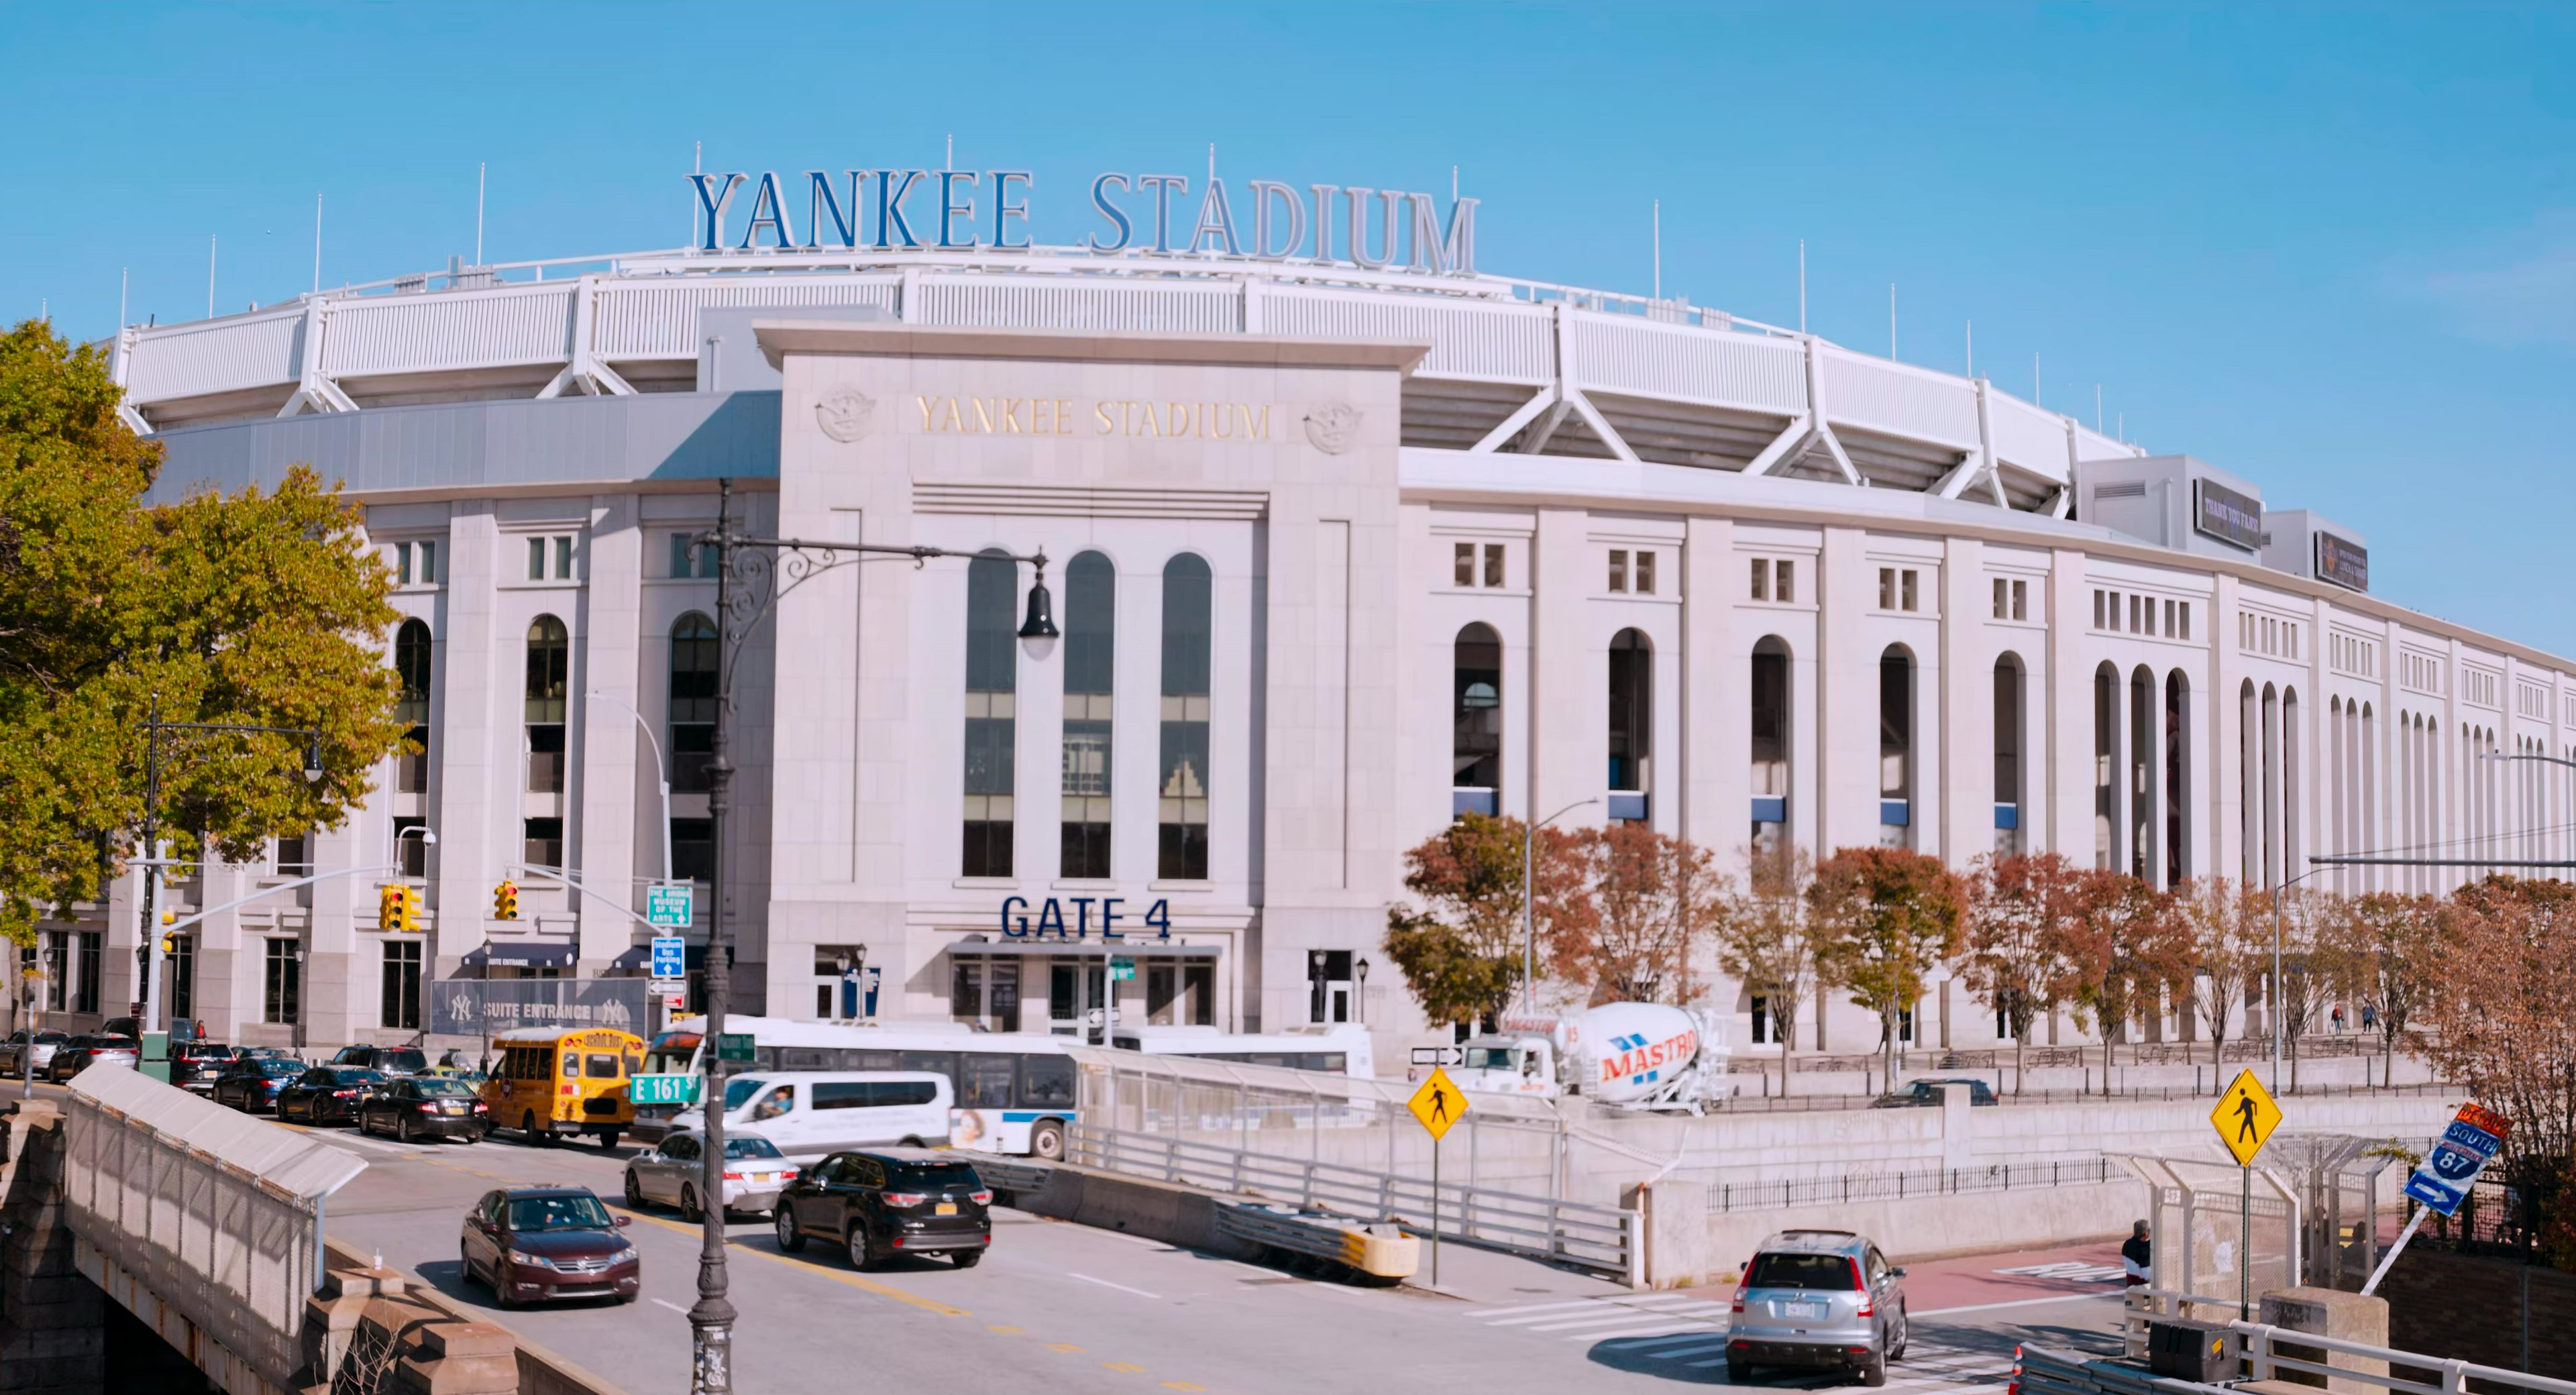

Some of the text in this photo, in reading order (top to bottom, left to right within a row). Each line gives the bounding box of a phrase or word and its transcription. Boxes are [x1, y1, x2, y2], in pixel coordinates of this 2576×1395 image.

[683, 170, 1481, 276] YANKEE STADIUM
[916, 395, 1271, 441] YANKEE STADIUM
[2205, 497, 2227, 521] THANK
[2227, 506, 2241, 526] YOU
[653, 897, 686, 905] MUSEUM
[666, 890, 690, 898] BRONX
[653, 914, 673, 922] ARTS
[1002, 896, 1171, 938] GATE 4
[655, 940, 682, 948] Stadium
[661, 948, 674, 956] Bus
[655, 956, 681, 965] Parking
[484, 1003, 591, 1020] SUITE ENTRANCE
[585, 1034, 622, 1048] SCHOOL BUS
[1601, 1029, 1696, 1085] MASTRO
[636, 1078, 645, 1100] E
[653, 1078, 680, 1100] 161
[2449, 1125, 2496, 1152] SOUTH
[2439, 1152, 2470, 1172] 87
